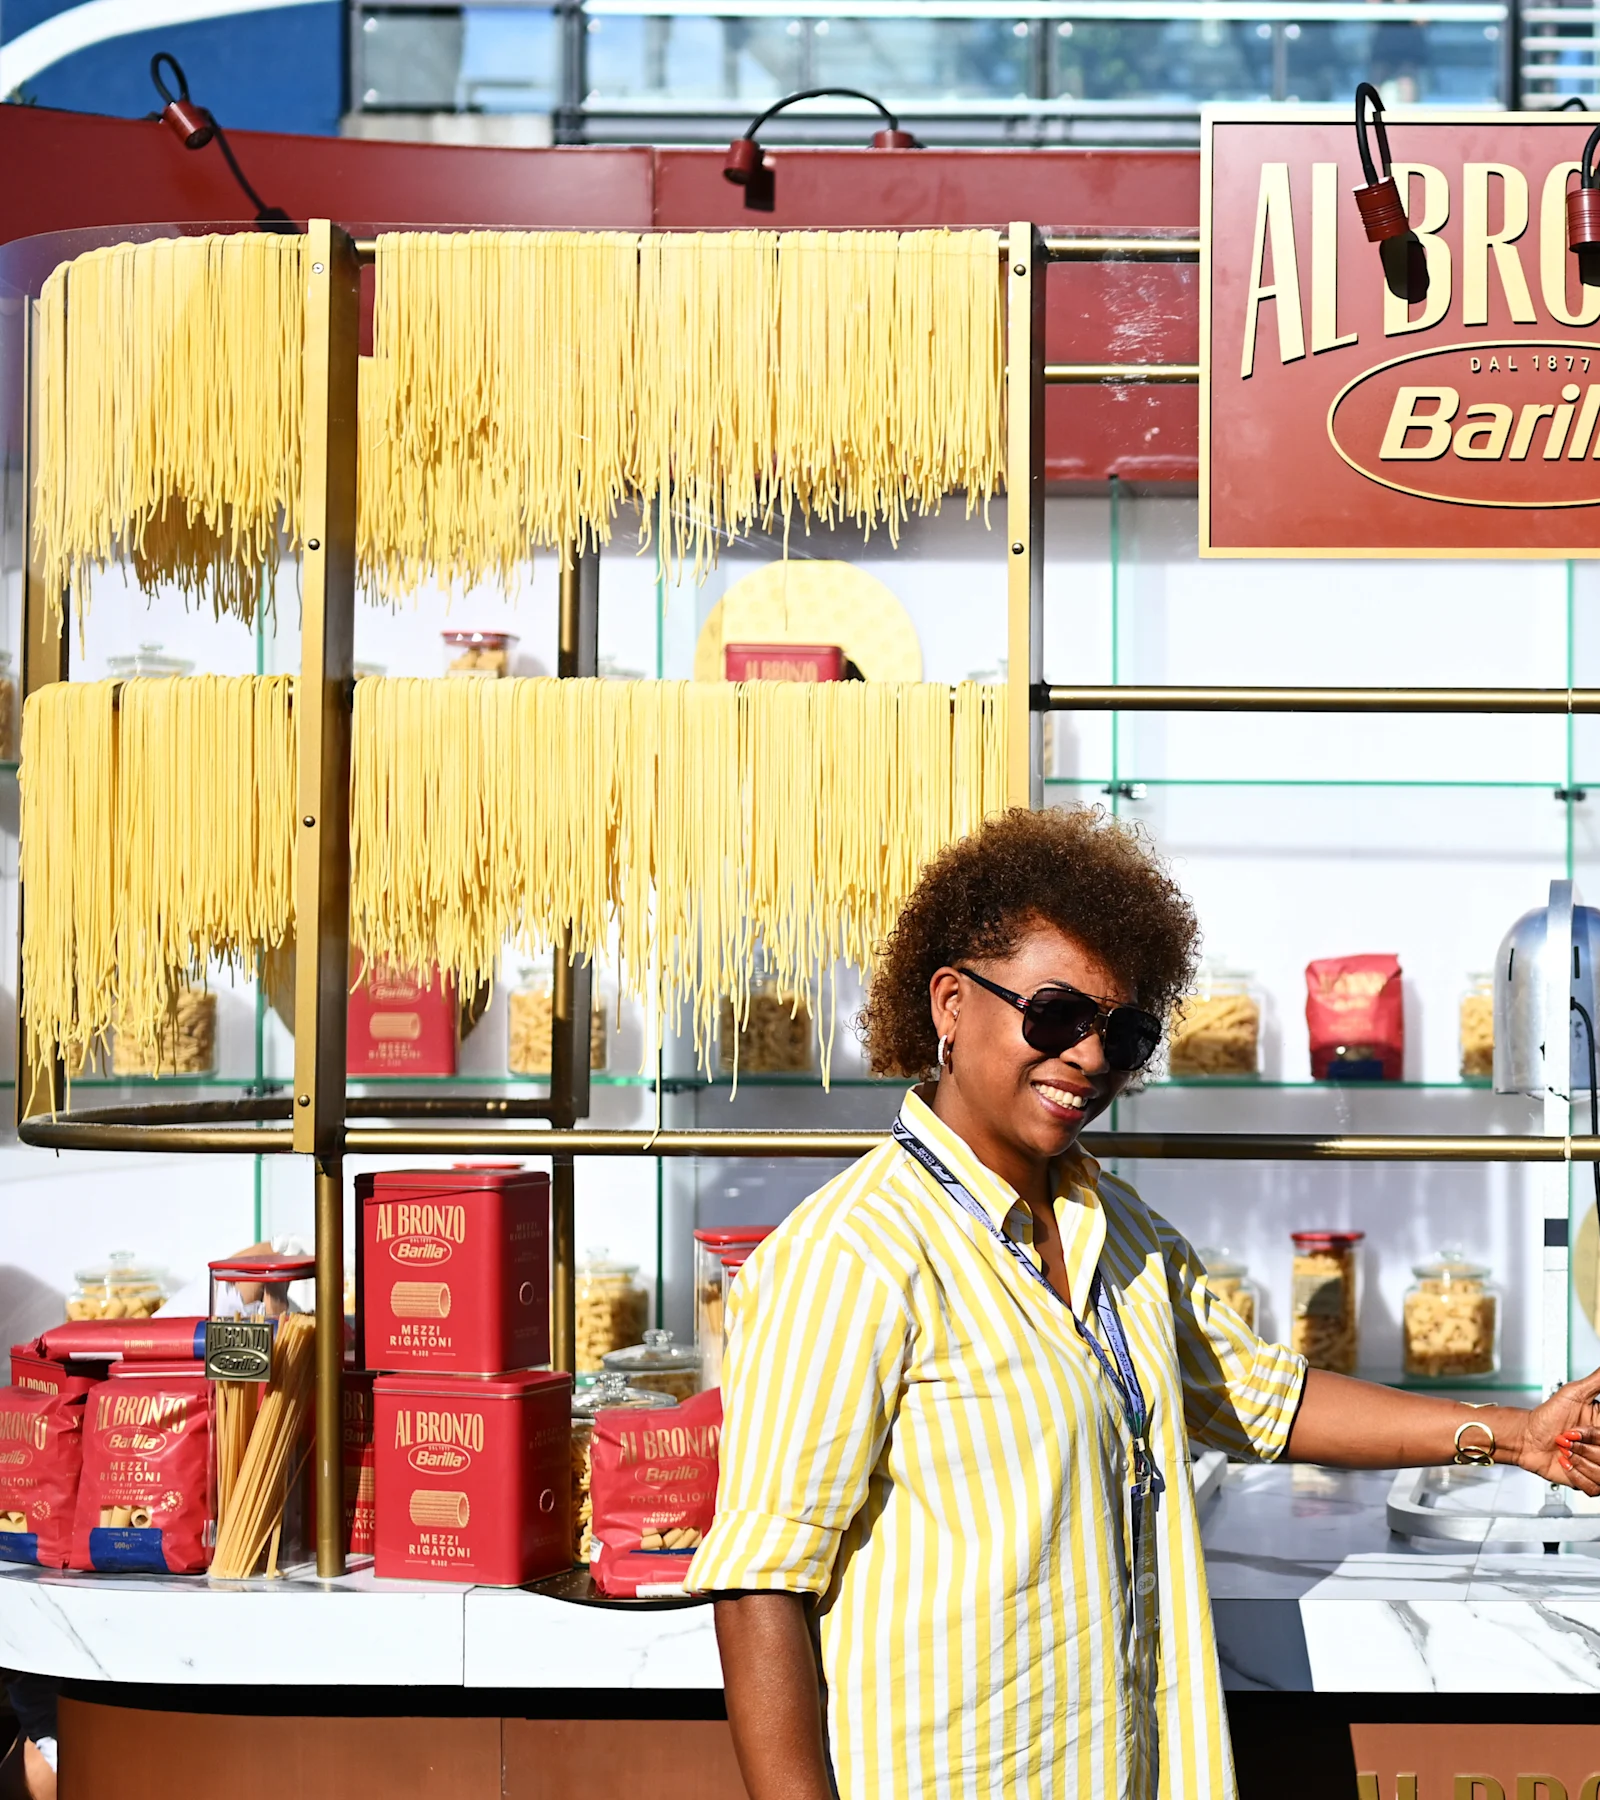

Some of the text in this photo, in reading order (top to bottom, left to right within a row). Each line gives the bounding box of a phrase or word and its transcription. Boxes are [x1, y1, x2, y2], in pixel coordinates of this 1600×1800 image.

[1240, 162, 1358, 378] AL
[1469, 355, 1593, 374] DAL 1877
[376, 1204, 466, 1244] AL BRONZO
[397, 1243, 445, 1259] Barilla
[401, 1325, 440, 1335] MEZZI
[224, 1325, 269, 1353] BRONZO
[389, 1336, 452, 1347] RIGATONI
[97, 1395, 112, 1433] AL
[113, 1395, 187, 1435] BRONZO
[395, 1410, 485, 1452] AL BRONZO
[109, 1433, 160, 1449] Barilla
[643, 1424, 721, 1461] BRONZO
[0, 1450, 27, 1465] arilla
[416, 1451, 463, 1468] Barilla
[110, 1461, 148, 1471] MEZZI
[645, 1465, 699, 1482] Barilla
[100, 1472, 162, 1482] RIGATONI
[420, 1533, 459, 1544] MEZZI
[408, 1544, 471, 1558] RIGATONI
